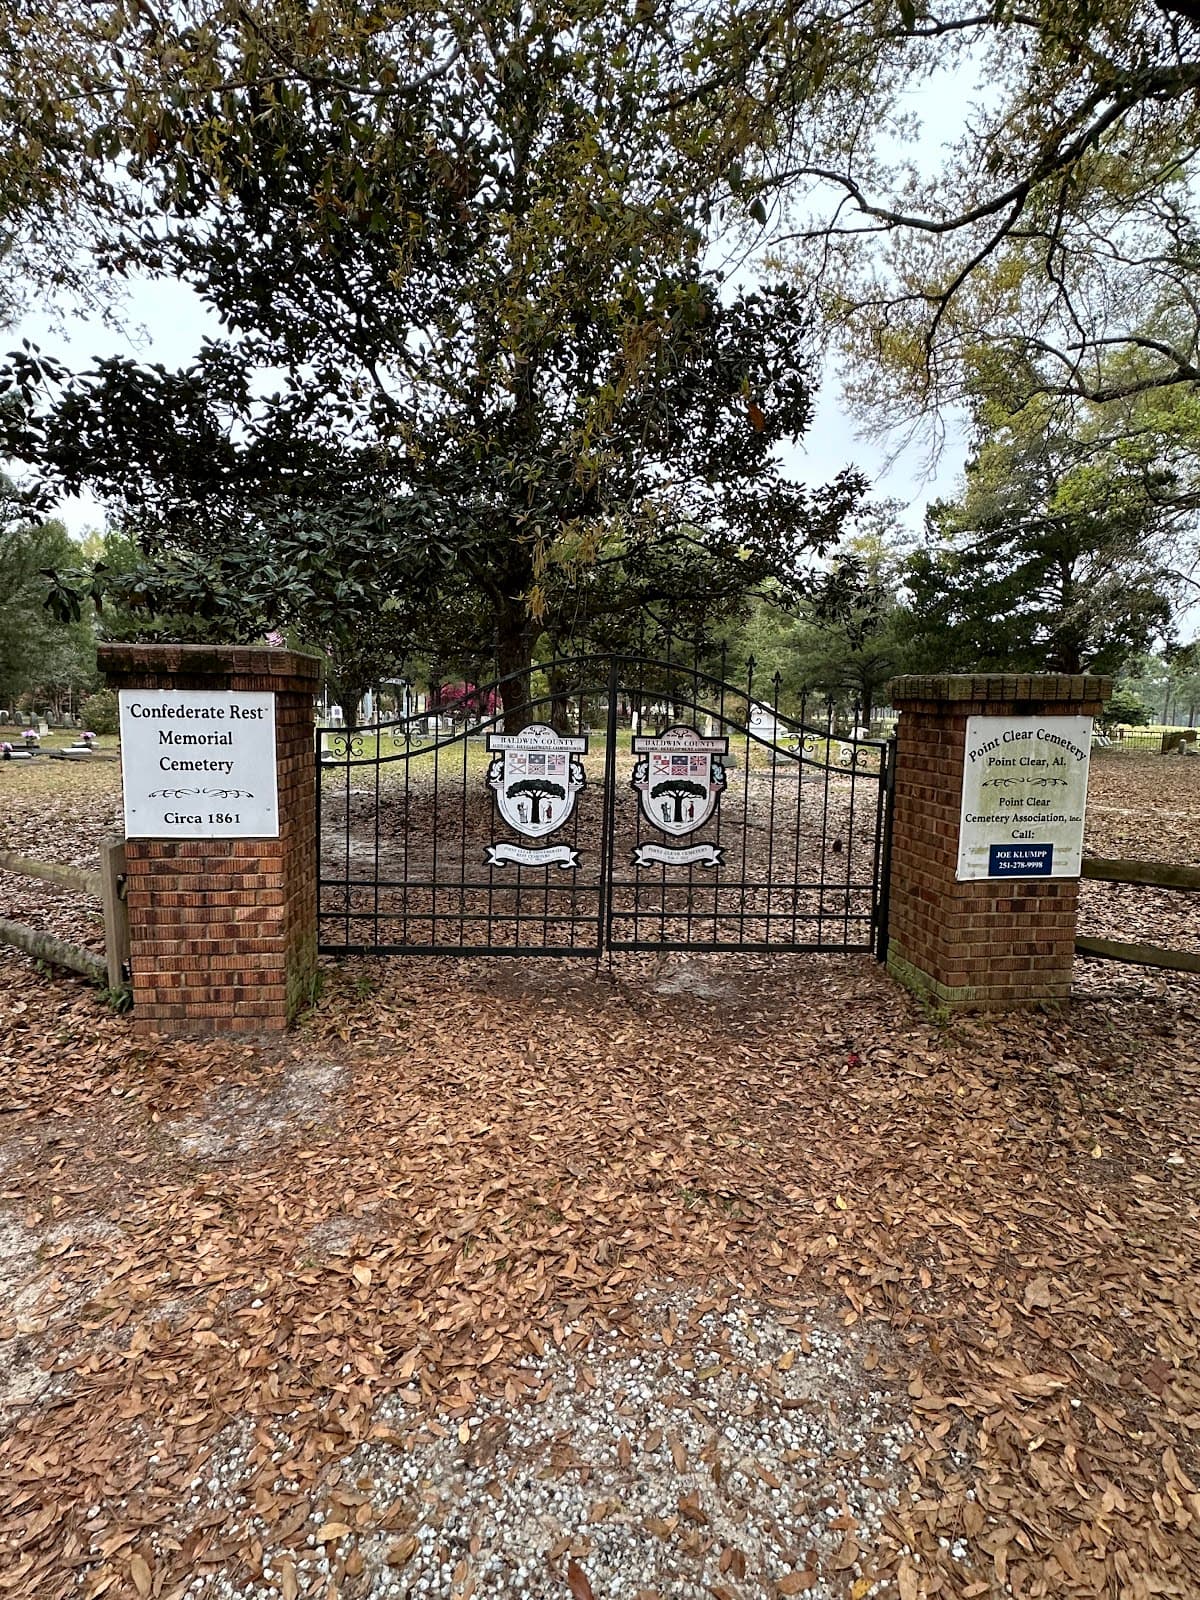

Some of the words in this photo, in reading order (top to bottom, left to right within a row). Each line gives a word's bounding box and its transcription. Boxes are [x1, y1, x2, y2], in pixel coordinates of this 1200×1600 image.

[130, 703, 225, 719] Confederate
[229, 705, 264, 720] Rest
[158, 730, 233, 745] Memorial
[500, 737, 538, 745] BALDWIN
[541, 738, 574, 746] COUNTY
[645, 739, 681, 747] BALDWIN
[684, 740, 715, 748] COUNTY
[968, 738, 1001, 763] Point
[1002, 729, 1034, 743] Clear
[1036, 728, 1087, 762] Cemetery
[159, 756, 234, 774] Cemetery
[988, 757, 1016, 766] Point
[1019, 757, 1049, 768] Clear,
[999, 798, 1024, 807] Point
[1026, 797, 1051, 807] Clear
[164, 812, 202, 824] Circa
[208, 813, 240, 824] 1861
[965, 814, 1010, 824] Cemetery
[1012, 813, 1067, 824] Association,
[1011, 830, 1035, 839] Call:
[996, 851, 1012, 859] JOE
[1012, 850, 1048, 859] KLUMPP
